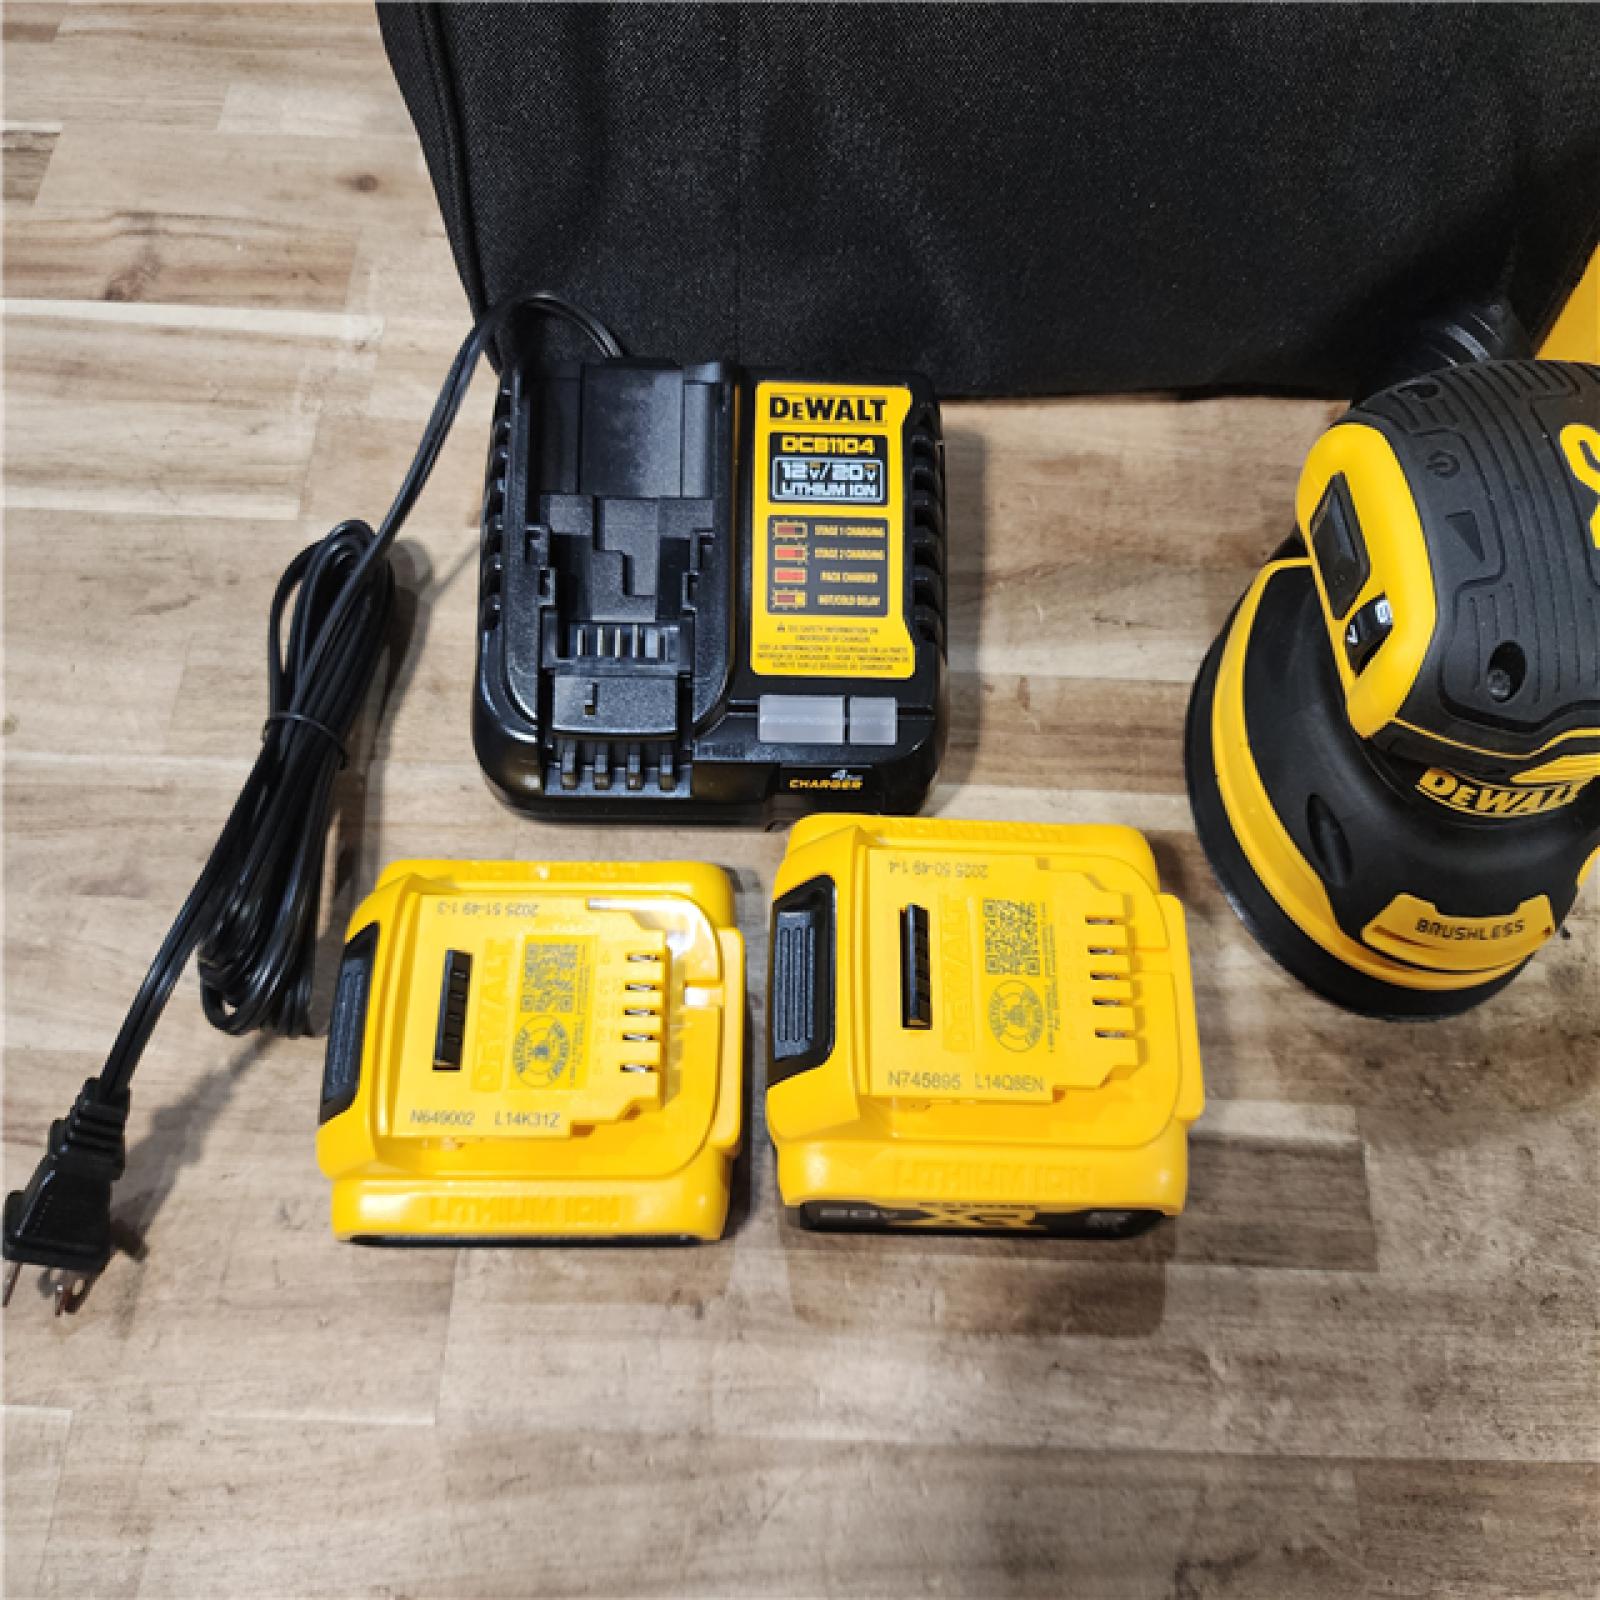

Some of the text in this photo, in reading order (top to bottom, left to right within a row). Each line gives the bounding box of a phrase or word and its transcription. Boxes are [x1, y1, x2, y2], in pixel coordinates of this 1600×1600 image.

[769, 396, 887, 422] DEWALT
[781, 436, 875, 454] DCB1104
[782, 482, 876, 497] LITHIUM ION
[1414, 916, 1527, 940] BRUSHLESS
